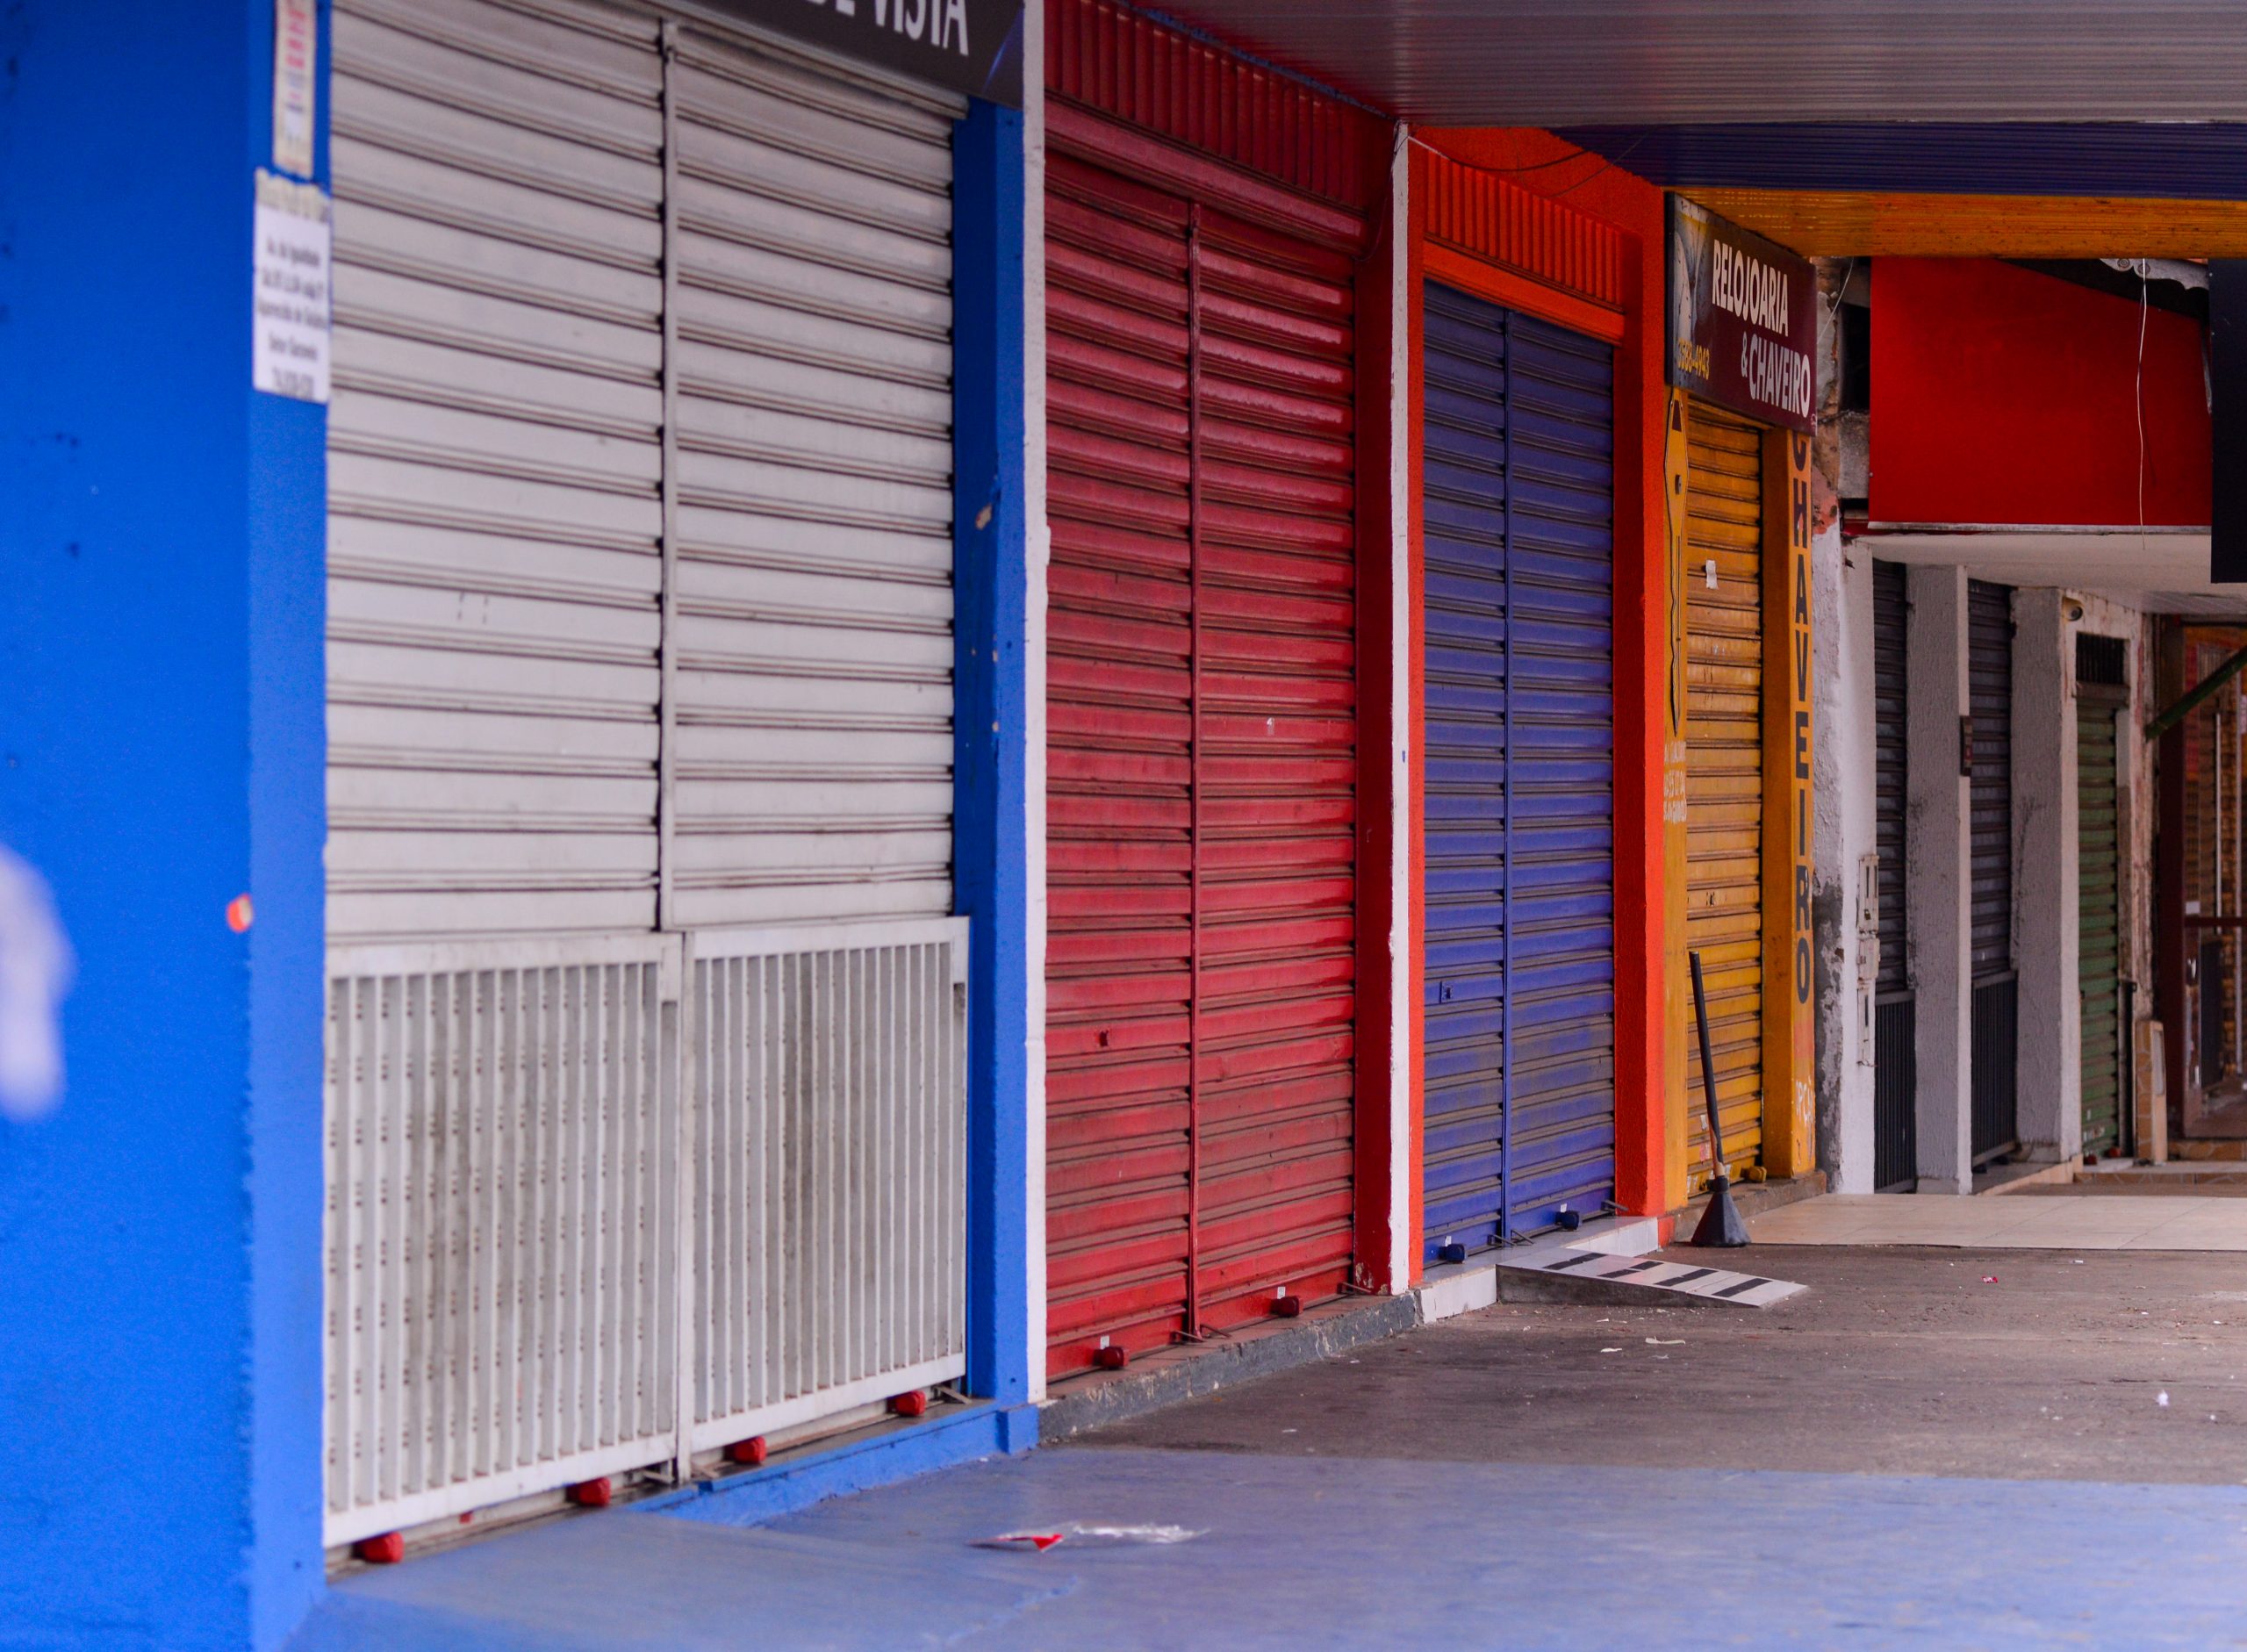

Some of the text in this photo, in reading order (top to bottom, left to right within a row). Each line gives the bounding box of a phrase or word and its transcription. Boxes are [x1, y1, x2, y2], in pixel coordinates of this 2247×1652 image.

[1712, 239, 1788, 337] RELOJOARIA
[1741, 331, 1810, 418] & CHAVEIRO
